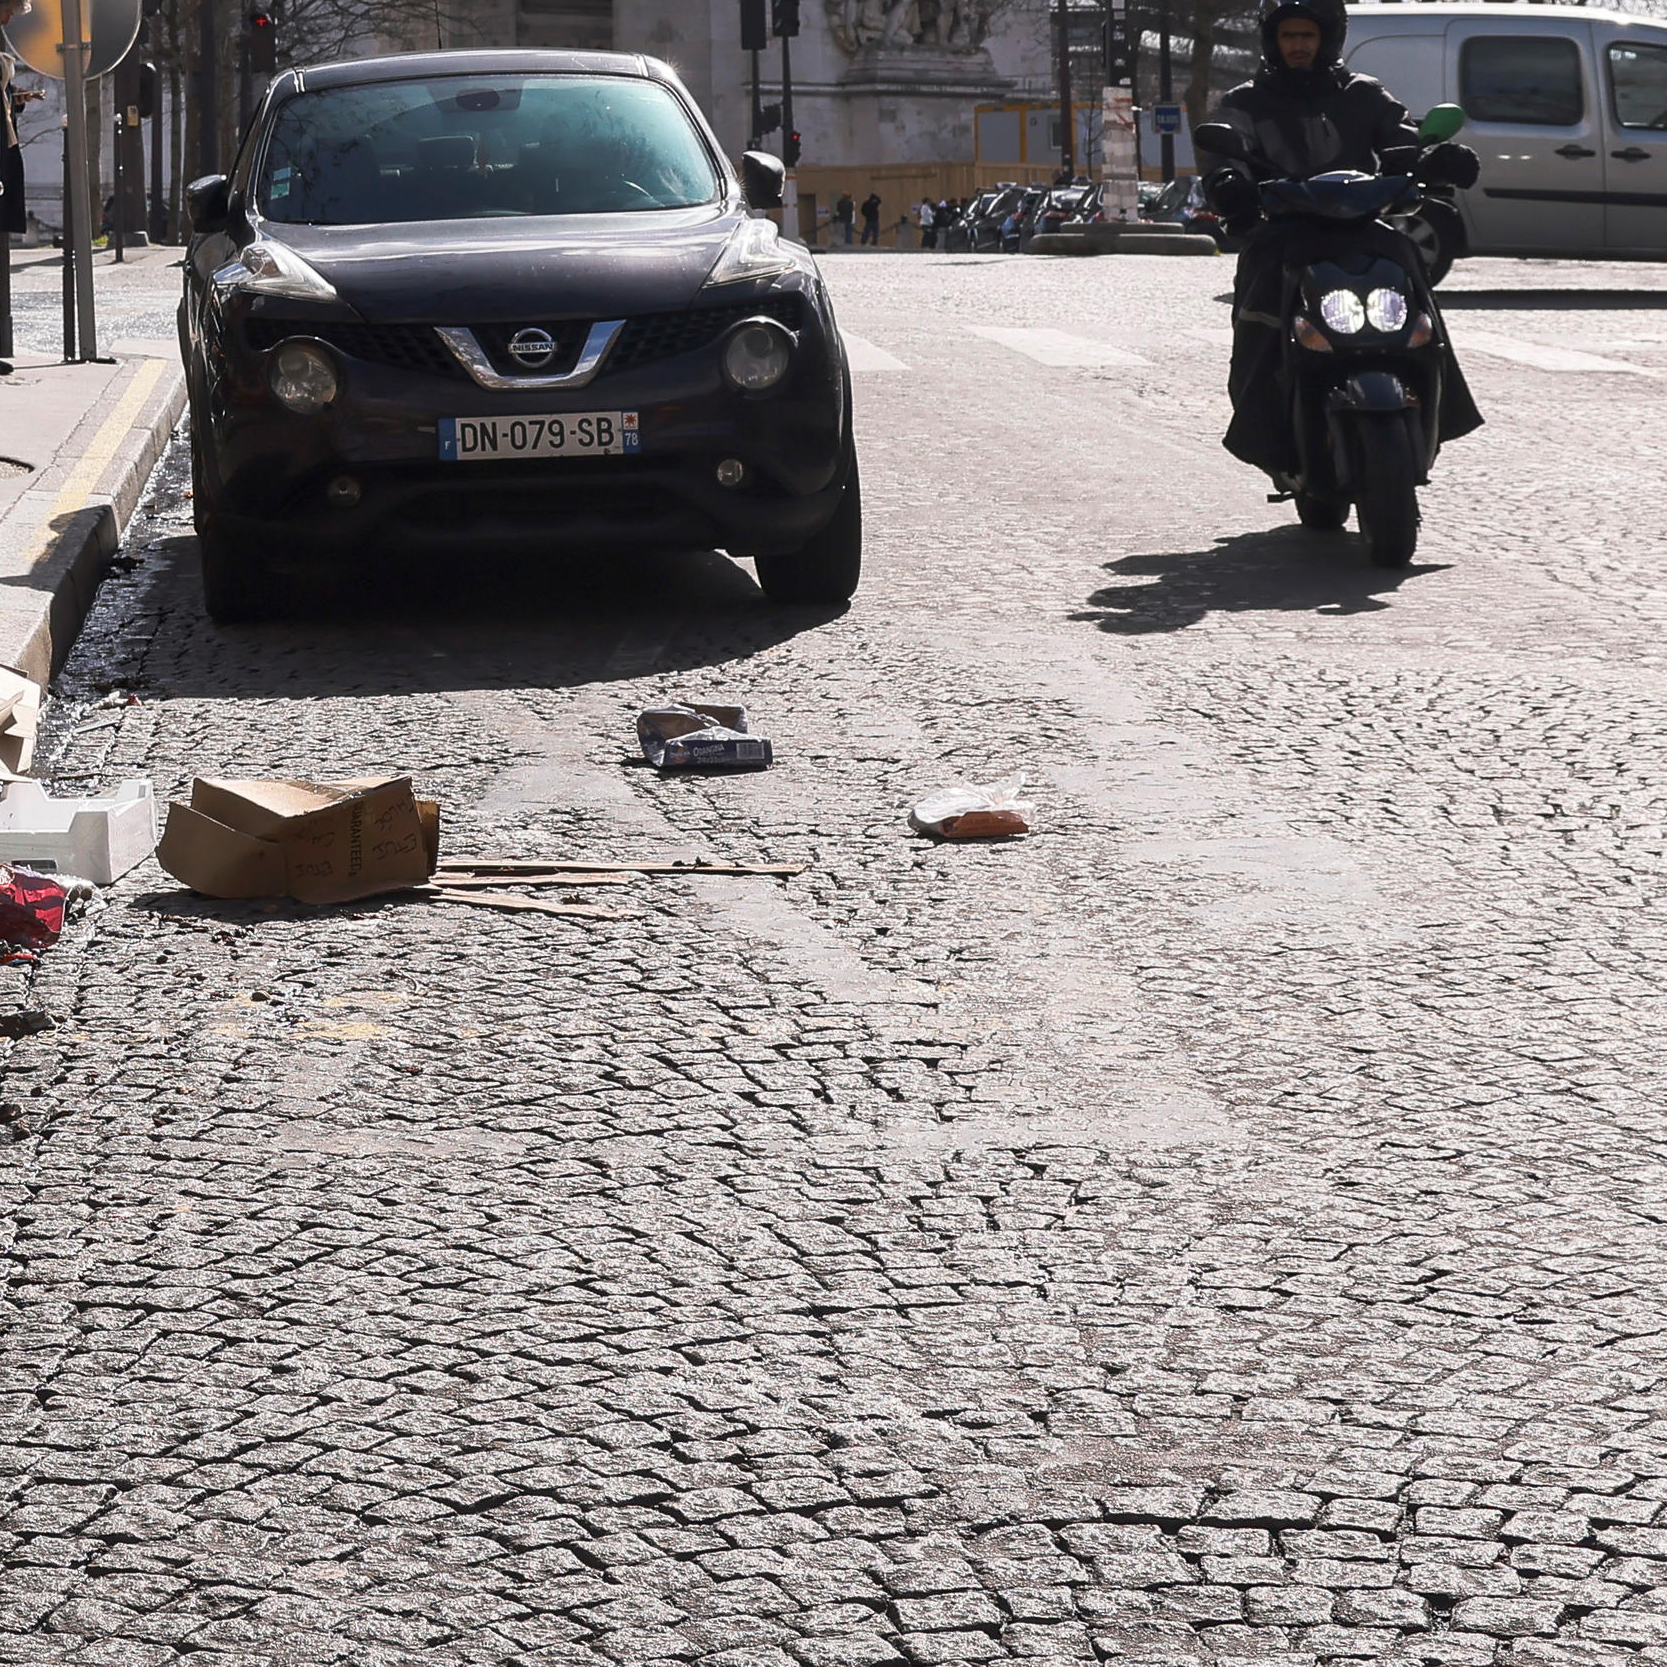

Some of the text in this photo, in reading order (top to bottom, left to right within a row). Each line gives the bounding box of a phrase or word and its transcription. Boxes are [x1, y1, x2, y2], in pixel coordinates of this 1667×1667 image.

[512, 343, 554, 352] NISSAN
[460, 418, 615, 453] DN-079-SB
[625, 433, 639, 446] 78
